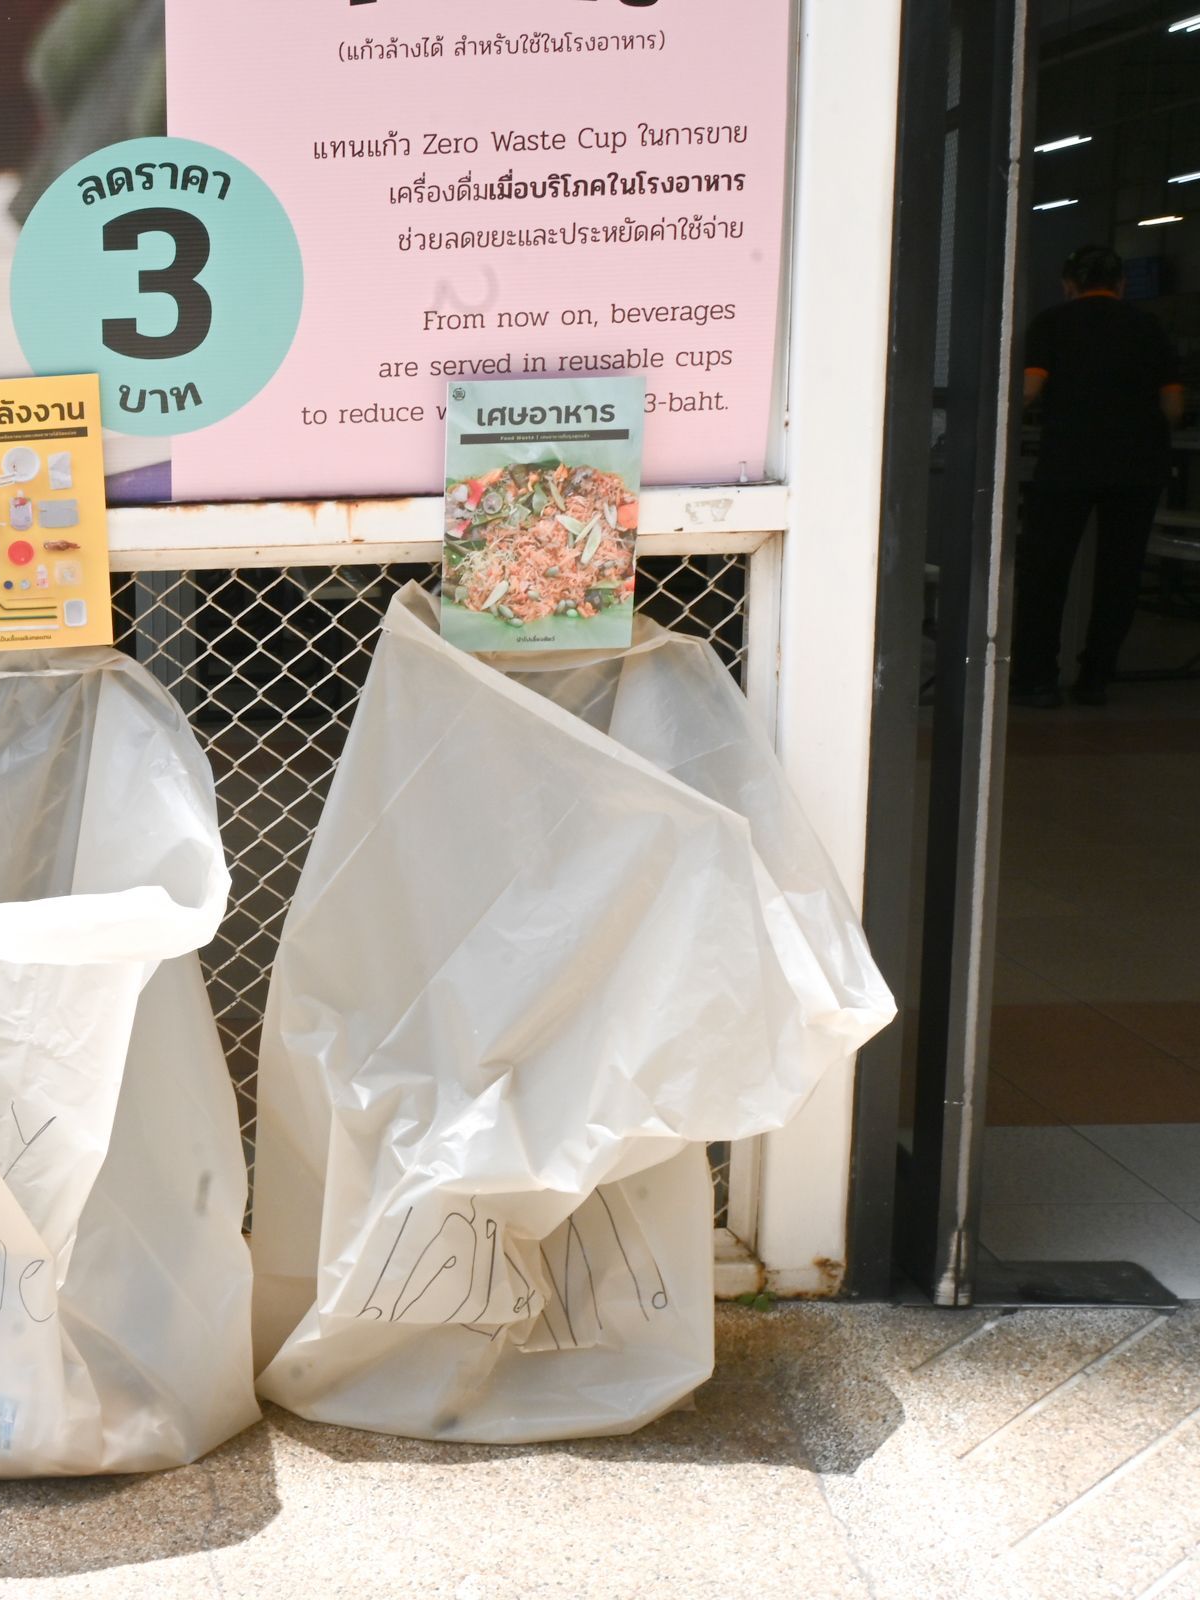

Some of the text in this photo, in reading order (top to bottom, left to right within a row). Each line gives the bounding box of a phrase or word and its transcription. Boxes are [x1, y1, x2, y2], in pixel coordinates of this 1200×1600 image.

[338, 30, 666, 62] (แก้วล้างได้ สำหรับใช้ในโรงอาหาร)
[313, 122, 748, 160] แทนแก้ว Zero Waste Cup ในการขาย
[78, 161, 232, 206] ลดราคา
[398, 215, 744, 252] ช่วยลดขยะและประหยัดค่าใช้จ่าย
[101, 206, 213, 360] 3
[423, 302, 736, 331] From now on, beverages
[378, 347, 733, 378] are served in reusable cups
[118, 381, 203, 414] บาท
[301, 406, 328, 426] to
[338, 402, 424, 424] reduce
[477, 404, 616, 427] เศษอาหาร
